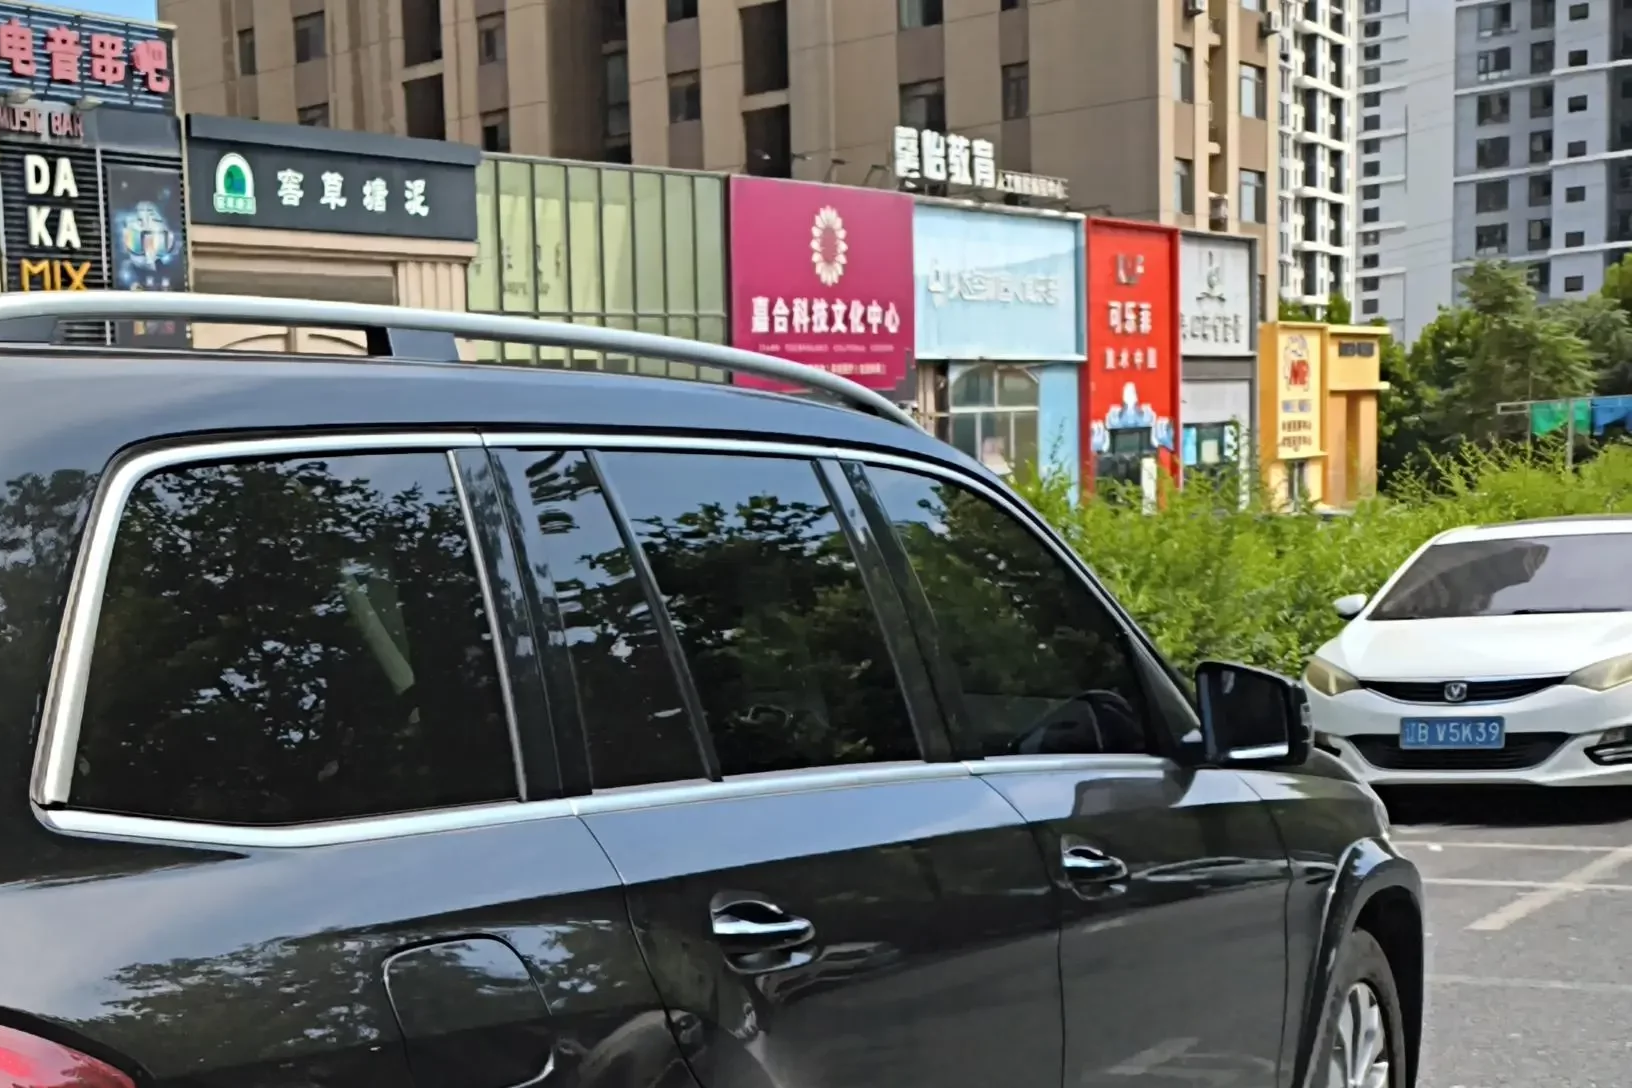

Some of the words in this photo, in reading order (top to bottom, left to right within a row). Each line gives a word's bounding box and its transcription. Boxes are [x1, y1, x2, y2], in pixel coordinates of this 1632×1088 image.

[50, 110, 85, 137] BAR
[24, 155, 79, 198] DA
[27, 205, 82, 249] KA
[20, 259, 91, 292] MIX
